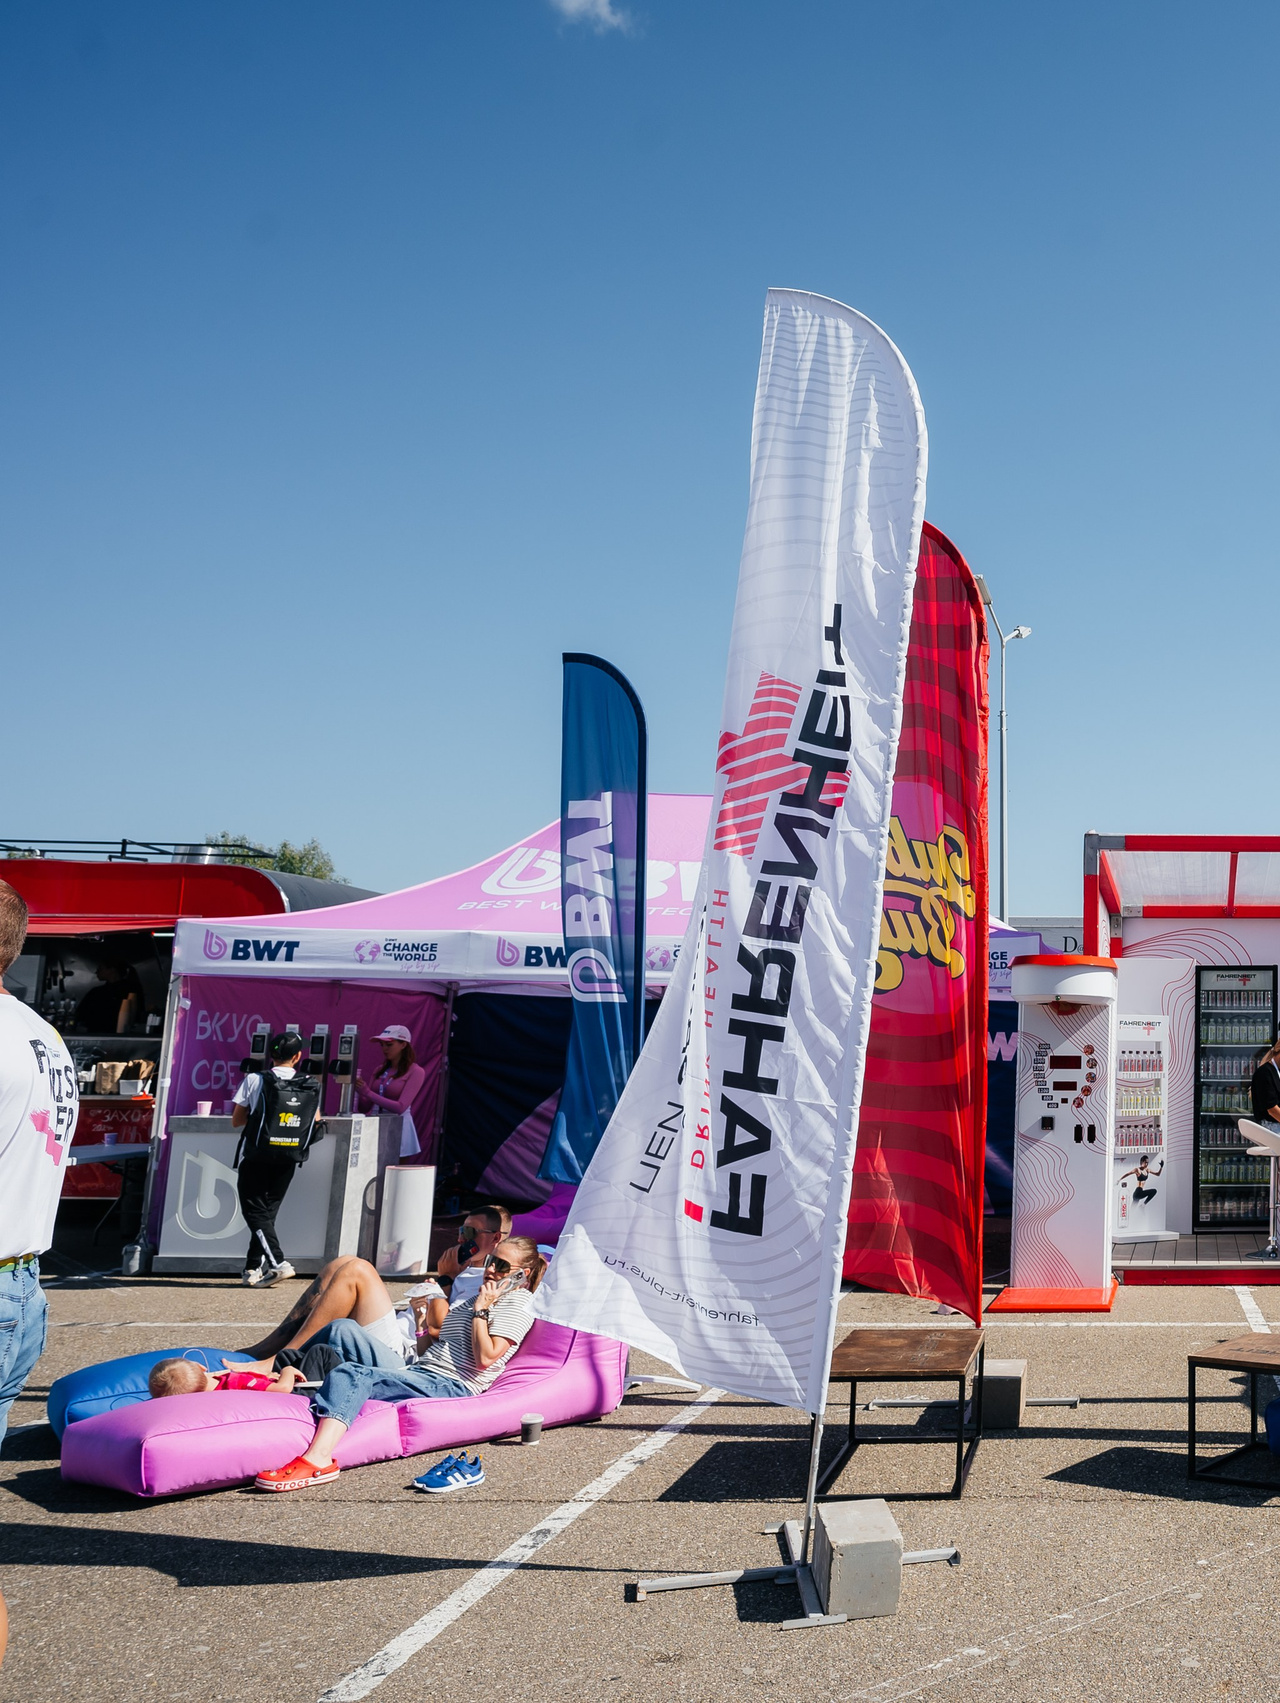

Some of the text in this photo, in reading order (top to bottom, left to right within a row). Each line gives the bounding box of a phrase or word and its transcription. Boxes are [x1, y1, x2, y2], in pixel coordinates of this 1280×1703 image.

[456, 899, 533, 910] BEST
[647, 906, 694, 916] TEC
[231, 939, 300, 962] BWT
[383, 942, 438, 952] CHANGE
[393, 953, 437, 962] WORLD
[524, 946, 568, 968] BW
[988, 961, 1008, 969] RLD
[196, 1010, 264, 1044] ВКУС
[191, 1059, 241, 1090] СВЕ
[275, 1479, 309, 1490] crocs
